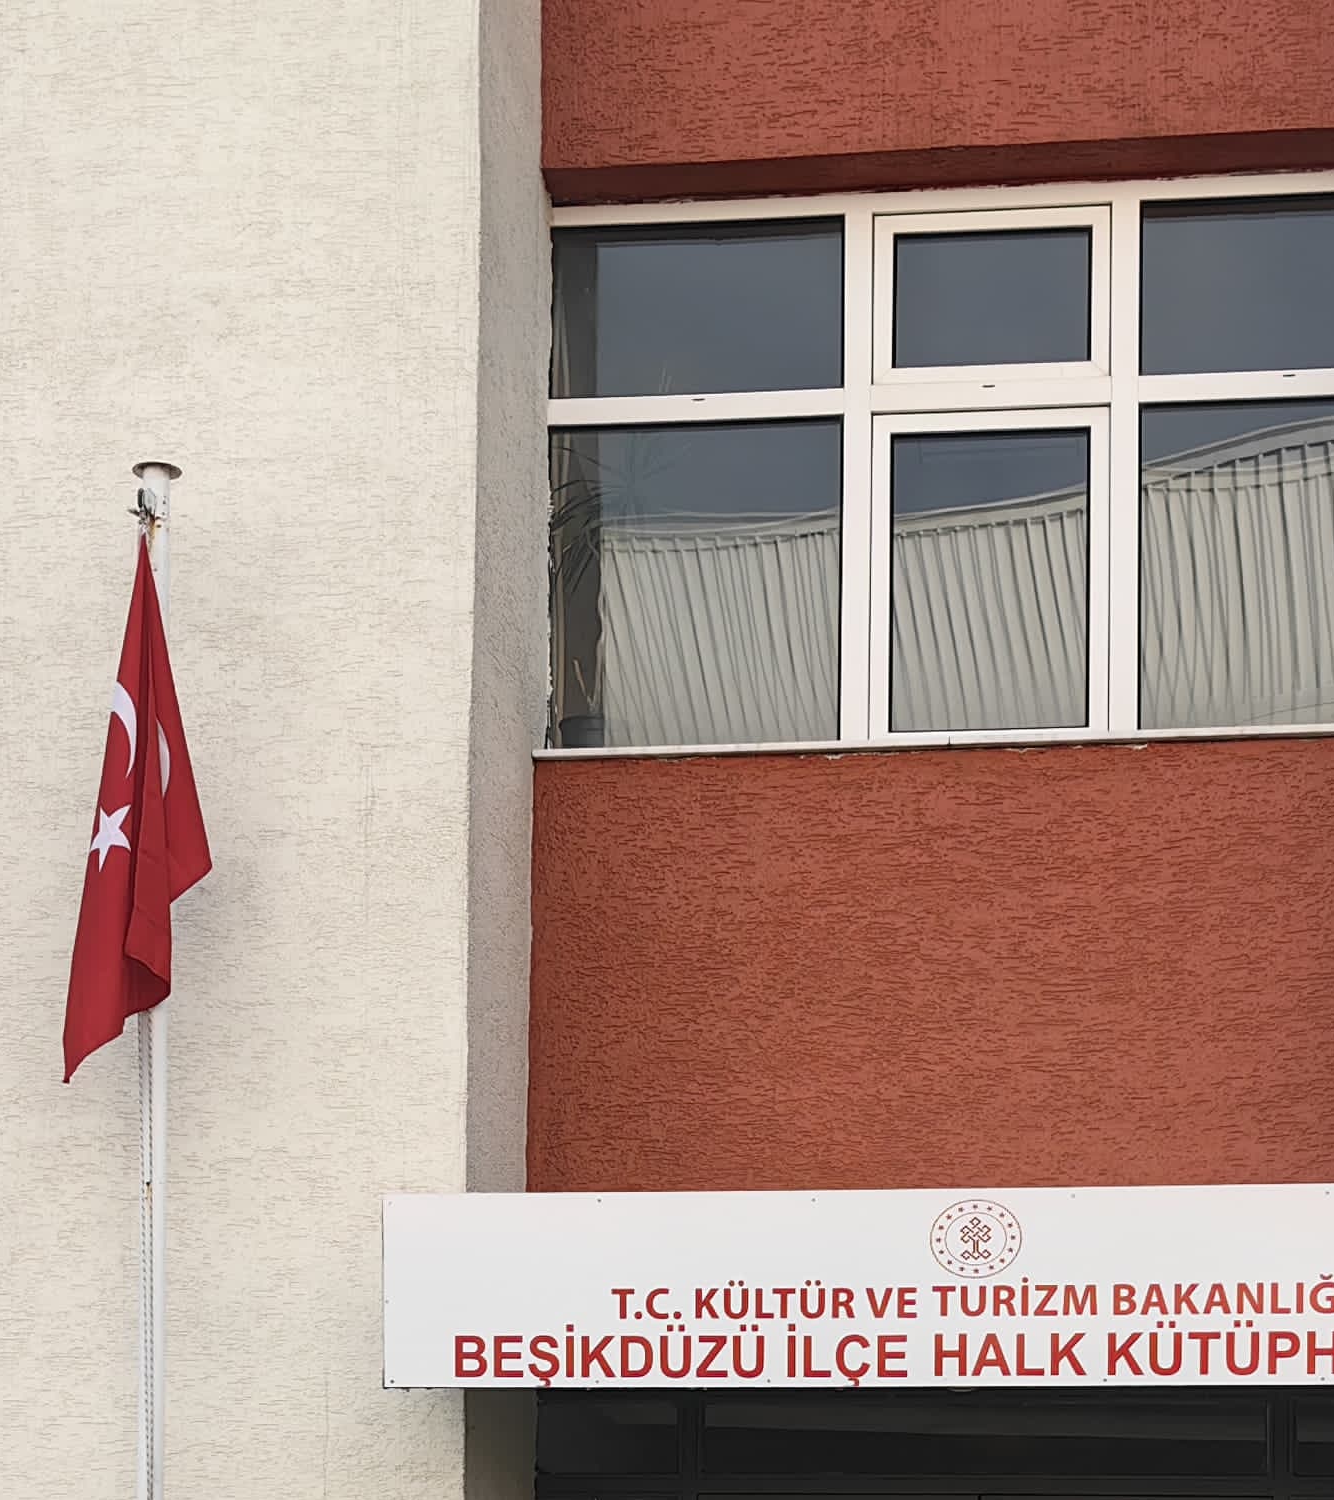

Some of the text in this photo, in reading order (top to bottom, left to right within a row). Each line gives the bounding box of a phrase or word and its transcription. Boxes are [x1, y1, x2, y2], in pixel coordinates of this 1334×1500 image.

[611, 1287, 682, 1320] T.C.
[694, 1279, 855, 1320] KÜLTÜR
[866, 1287, 918, 1319] VE
[932, 1276, 1099, 1318] TURİZM
[454, 1324, 766, 1387] BEŞİKDÜZÜ
[787, 1323, 909, 1387] İLÇE
[934, 1333, 1087, 1377] HALK
